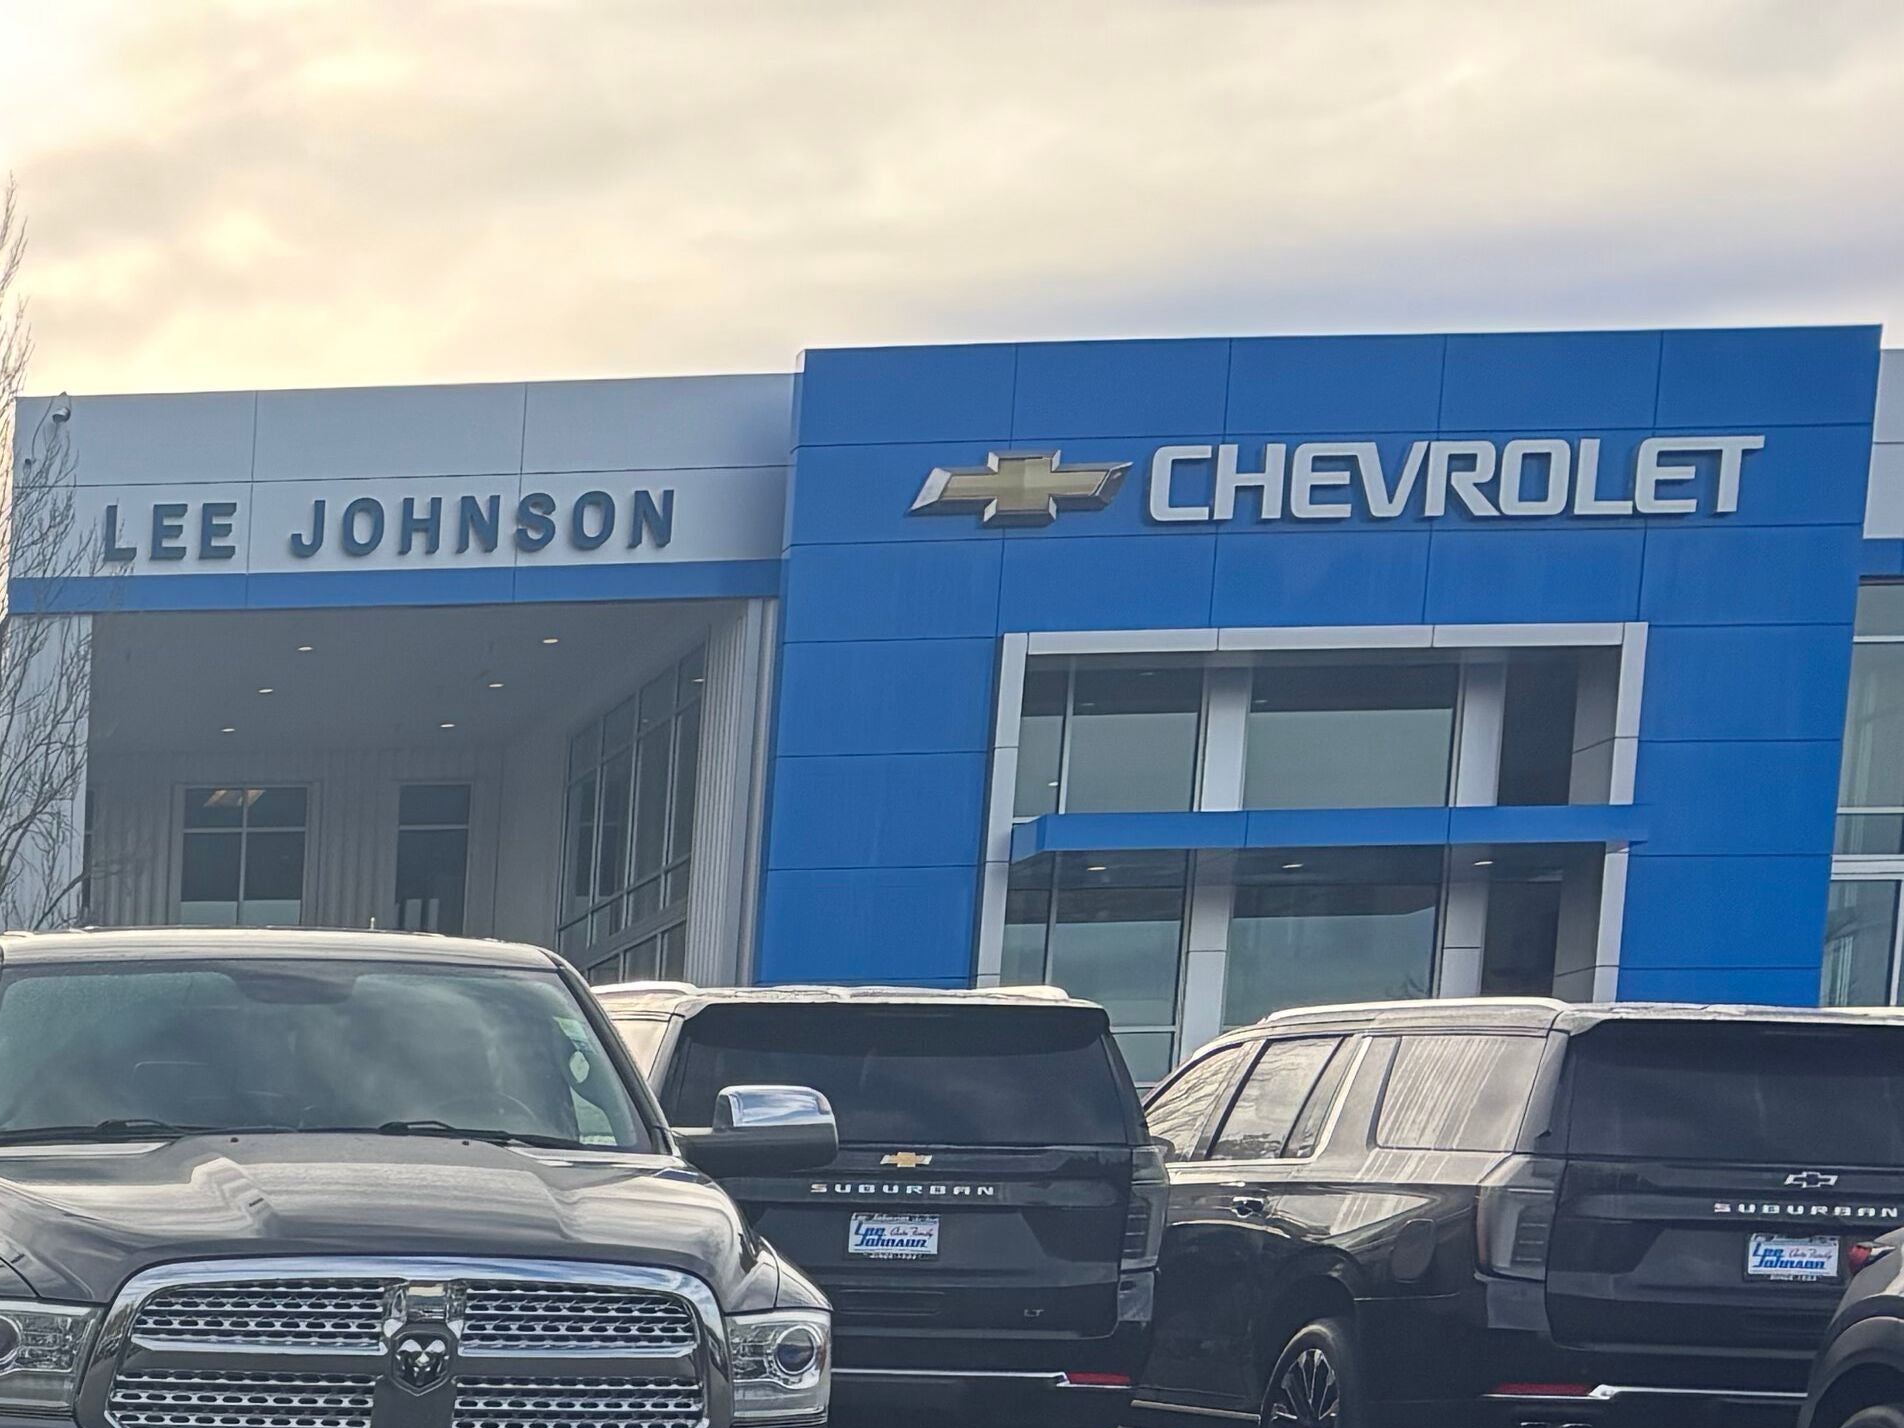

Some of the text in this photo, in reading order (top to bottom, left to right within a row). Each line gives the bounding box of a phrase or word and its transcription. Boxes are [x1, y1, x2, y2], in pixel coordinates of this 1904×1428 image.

[1149, 434, 1765, 522] CHEVROLET
[101, 489, 674, 562] LEE JOHNSON
[810, 1183, 995, 1196] SUBURBAN
[1714, 1203, 1898, 1218] SUBURBAN
[855, 1222, 887, 1236] Lee
[855, 1234, 928, 1248] Johnson
[1753, 1242, 1784, 1257] Lee
[1753, 1255, 1826, 1269] Johnson
[1023, 1309, 1044, 1317] LT
